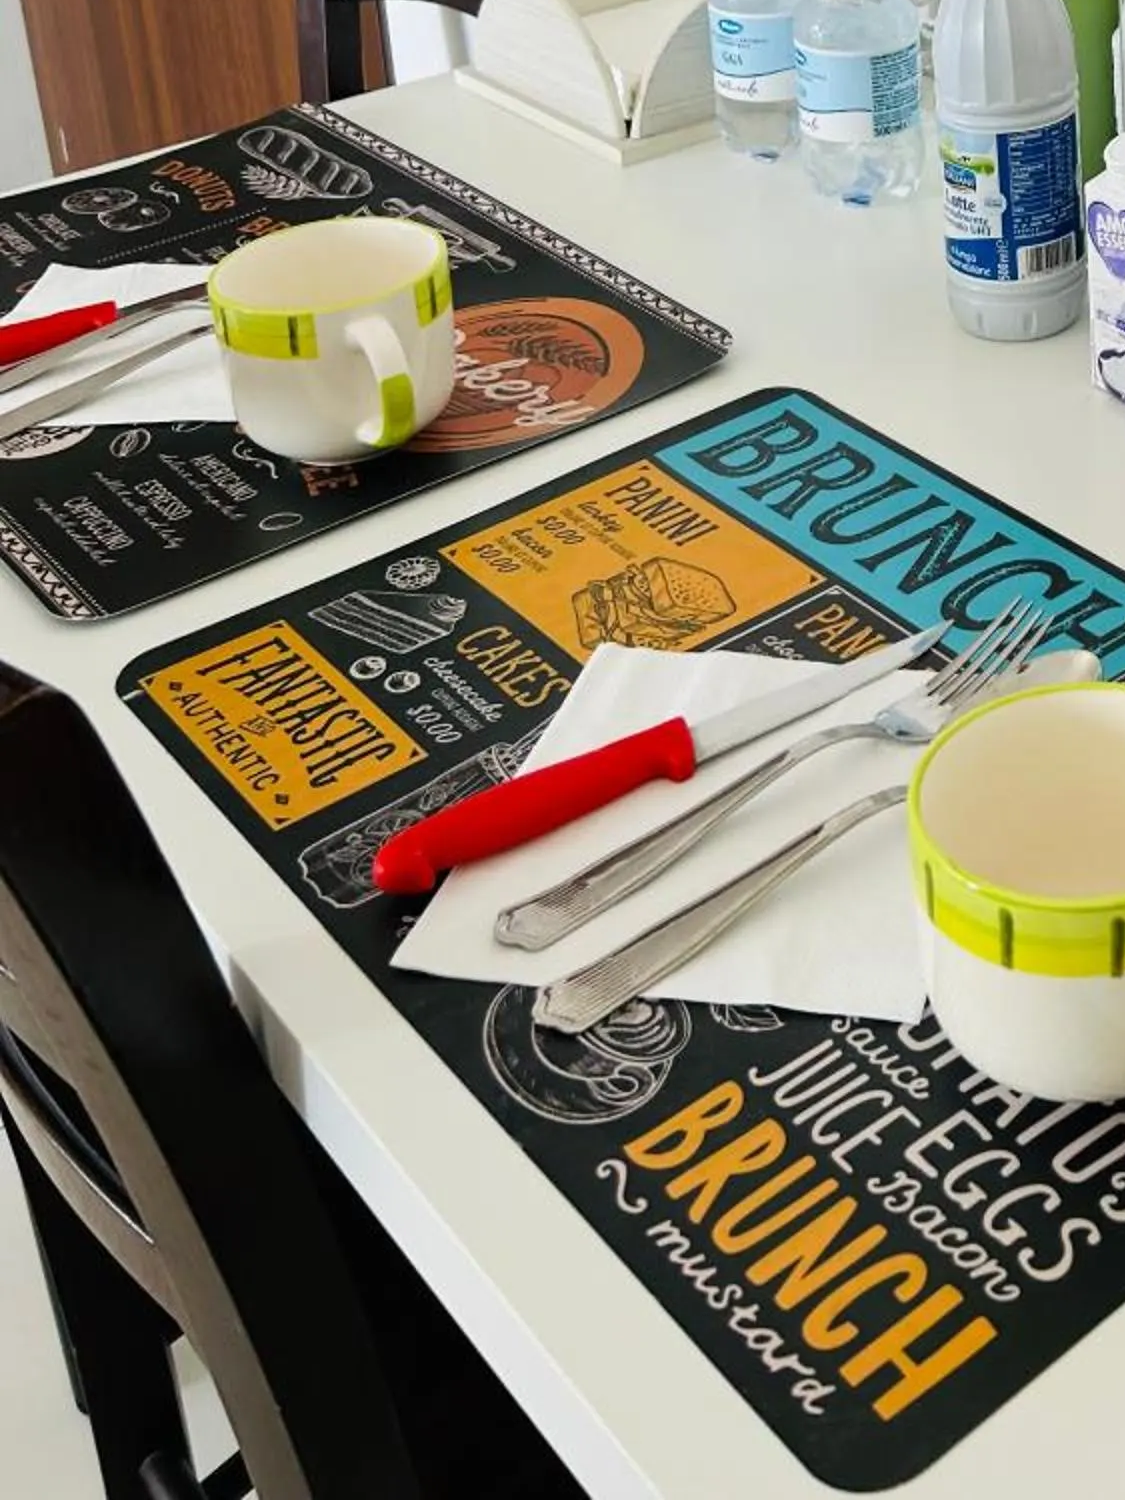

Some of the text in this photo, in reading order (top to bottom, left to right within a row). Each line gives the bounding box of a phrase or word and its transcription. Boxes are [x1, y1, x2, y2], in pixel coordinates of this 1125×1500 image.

[152, 159, 236, 212] DONUTS
[134, 478, 194, 522] ESPRESSO
[189, 453, 259, 501] AMERICANO
[602, 475, 720, 547] PANINI
[471, 542, 520, 573] $0.00
[536, 514, 586, 545] $0.00
[423, 656, 504, 723] cheesecake
[456, 625, 573, 708] CAKES
[174, 691, 280, 792] AUTHENTIC
[196, 635, 397, 789] FANTASTIC
[406, 703, 463, 744] $0.00
[831, 1016, 929, 1099] sauce
[749, 1037, 922, 1176] JUICE
[866, 1170, 1020, 1302] Bacon
[904, 1109, 1101, 1283] EGGS
[621, 1078, 1000, 1424] BRUNCH
[645, 1219, 840, 1419] mustard
